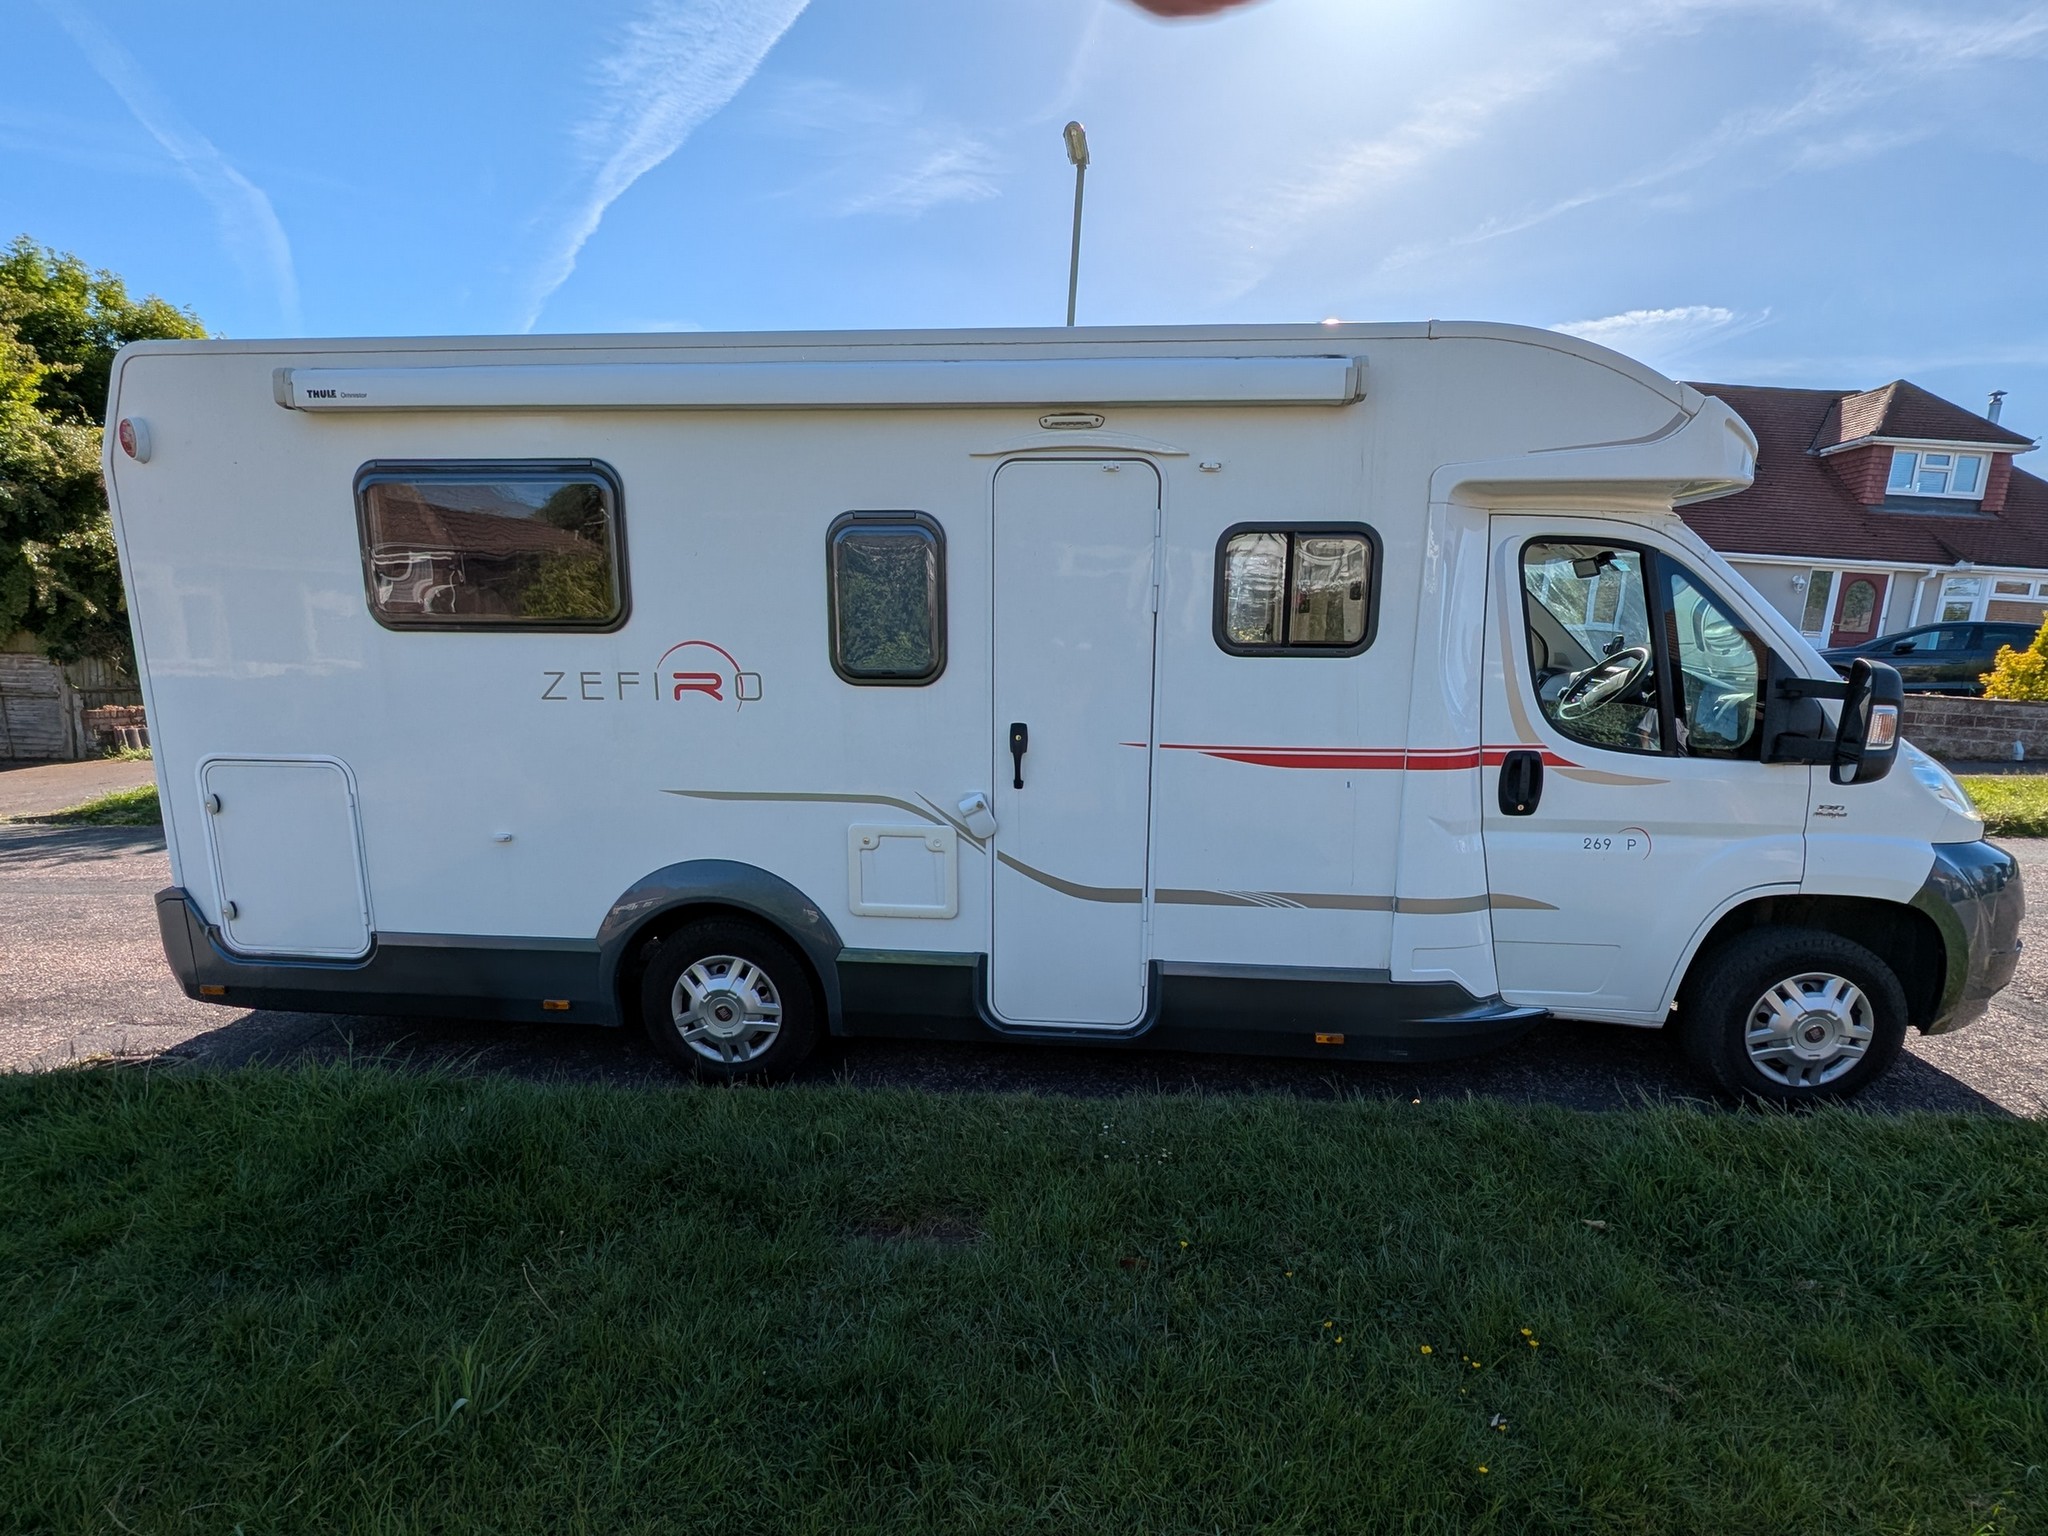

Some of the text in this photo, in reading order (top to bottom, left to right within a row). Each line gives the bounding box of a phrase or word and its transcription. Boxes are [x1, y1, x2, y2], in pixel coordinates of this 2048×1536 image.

[306, 389, 337, 399] THULE
[541, 671, 763, 702] ZEFIRO
[1583, 837, 1637, 851] 269 P
